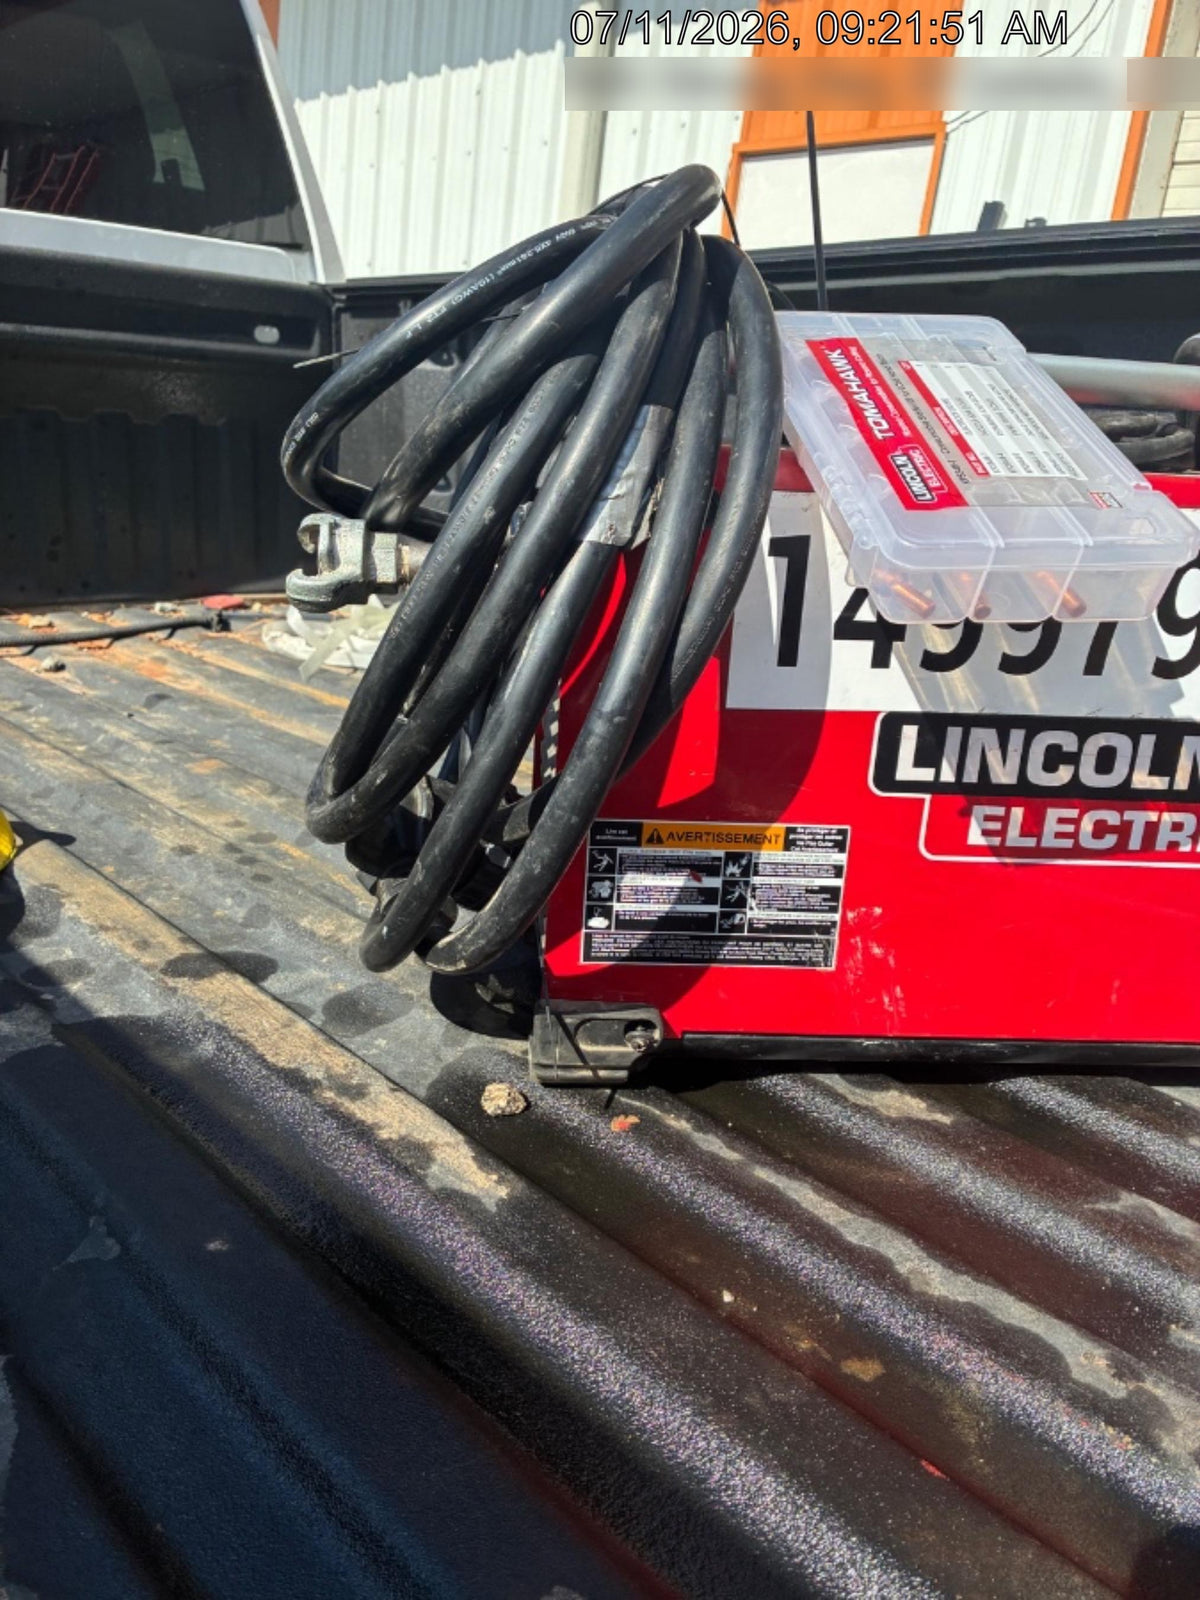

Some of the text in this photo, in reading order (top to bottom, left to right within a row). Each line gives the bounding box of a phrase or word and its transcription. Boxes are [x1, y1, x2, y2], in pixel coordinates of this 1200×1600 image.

[822, 348, 897, 439] TOMAHAWK
[890, 455, 934, 500] LINCOLN
[907, 449, 942, 486] ELECTRIC
[666, 831, 781, 845] AVERTISSEMENT
[967, 805, 1200, 854] ELECTR
